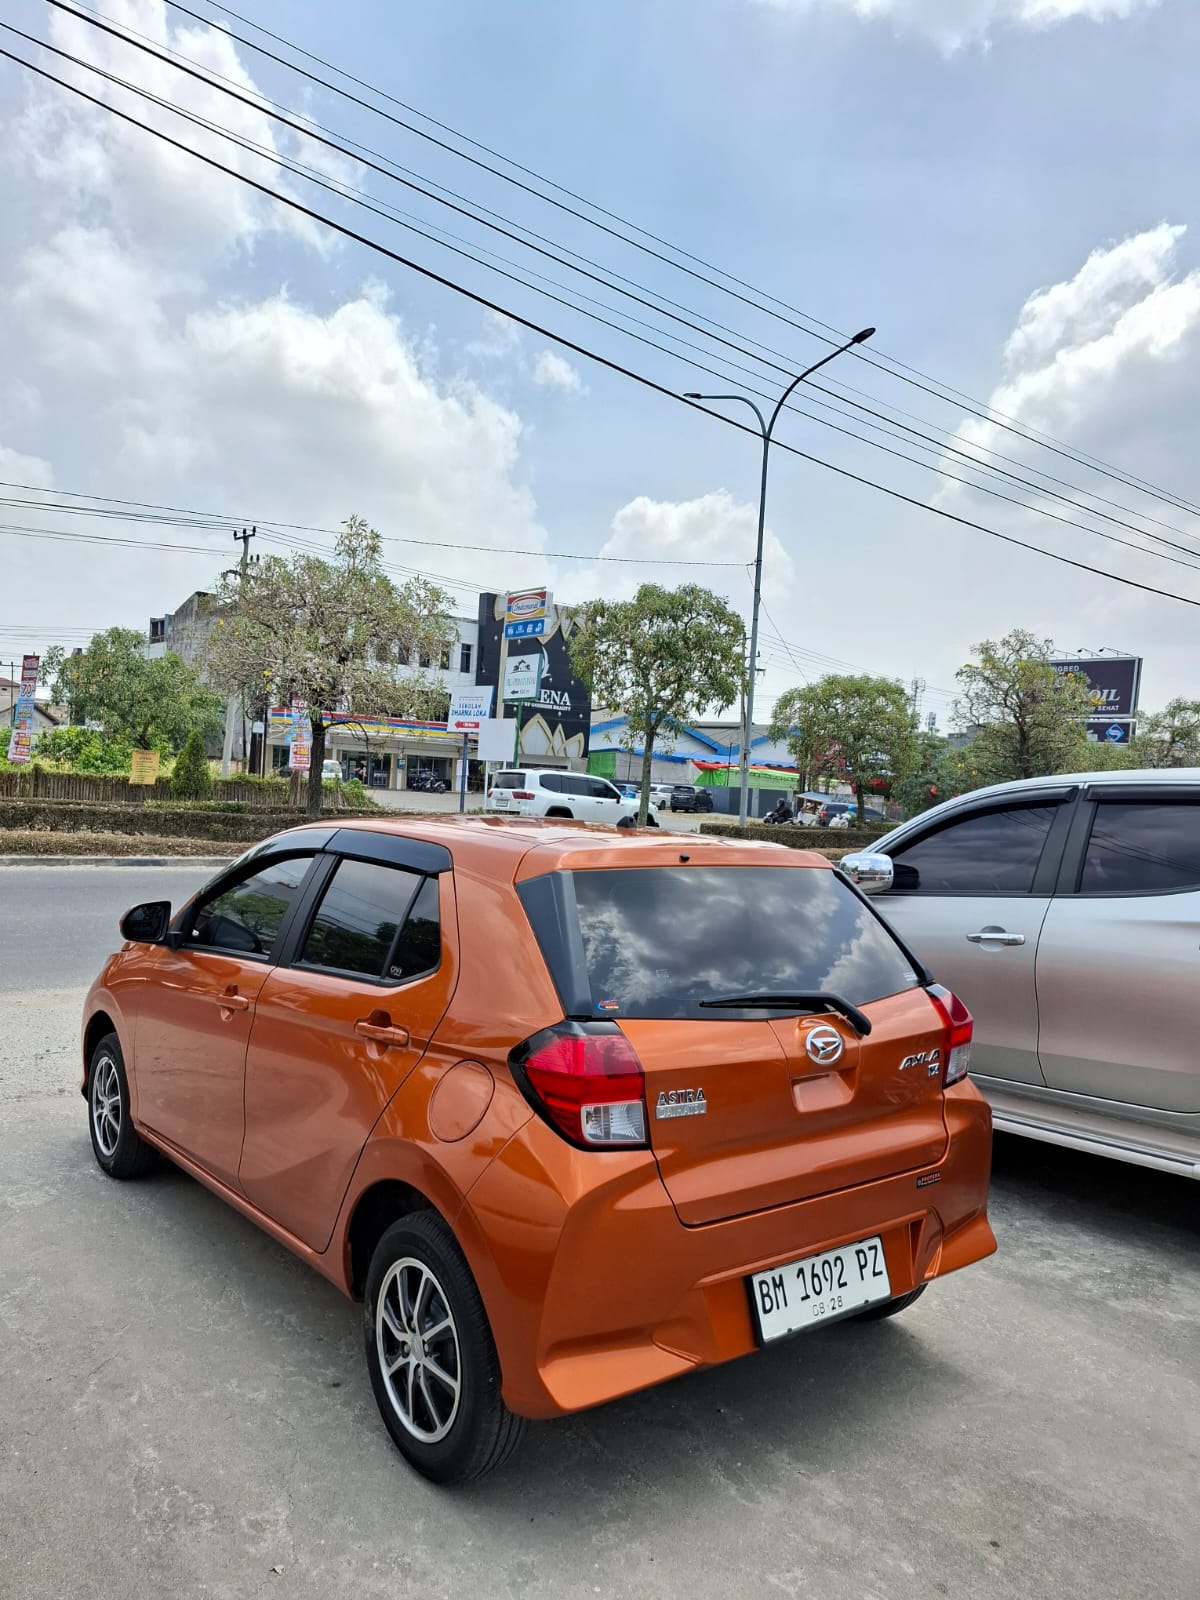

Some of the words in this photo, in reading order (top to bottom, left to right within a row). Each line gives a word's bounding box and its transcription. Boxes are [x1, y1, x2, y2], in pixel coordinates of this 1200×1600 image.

[657, 1087, 706, 1106] ASTRA
[758, 1273, 788, 1315] BM
[796, 1255, 848, 1302] 1692
[855, 1244, 883, 1281] PZ
